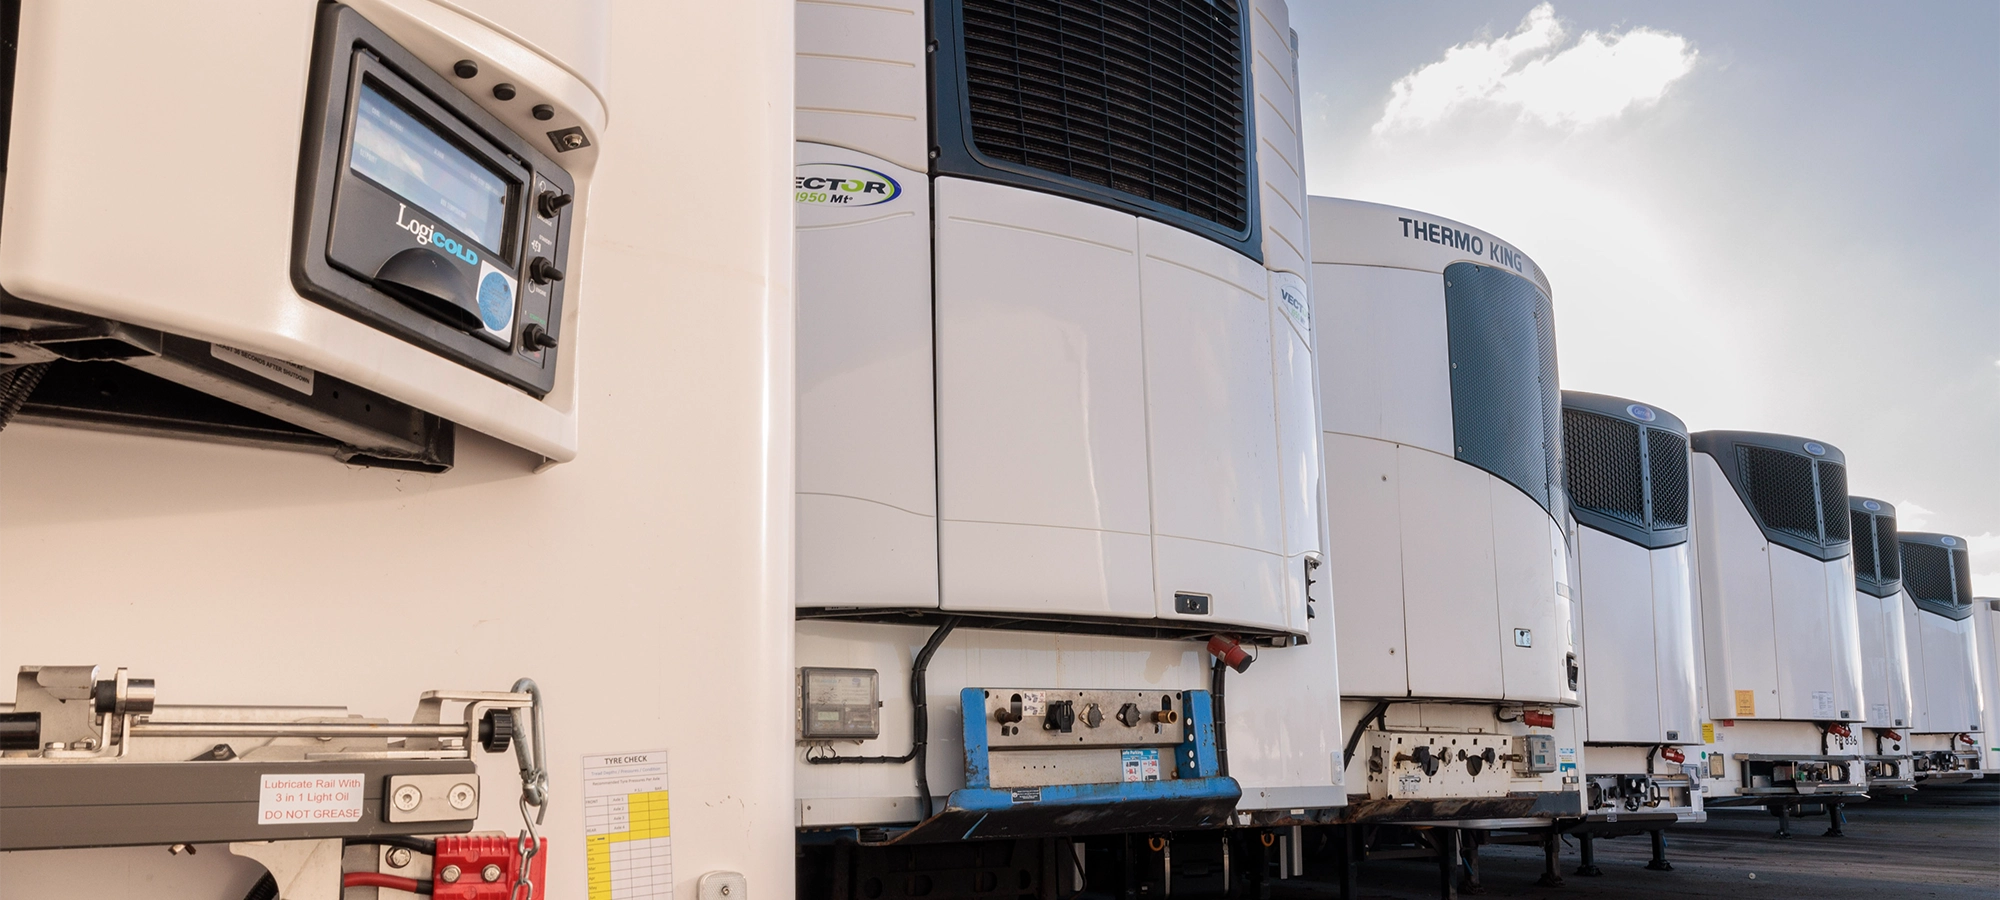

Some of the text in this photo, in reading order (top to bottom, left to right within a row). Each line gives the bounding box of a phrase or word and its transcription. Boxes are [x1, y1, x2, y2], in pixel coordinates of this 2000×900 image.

[796, 176, 886, 194] ECTOR
[396, 203, 478, 266] LogiCOLD
[1398, 217, 1523, 273] THERMO KING
[241, 350, 266, 366] SECONDS
[266, 361, 282, 373] AFTER
[283, 369, 310, 384] SHUTDOWN
[604, 755, 648, 765] TYRE CHECK
[265, 779, 361, 789] Lubricate Rail With
[275, 792, 349, 804] 3 in 1 Light Oil
[265, 808, 360, 820] DO NOT GREASE
